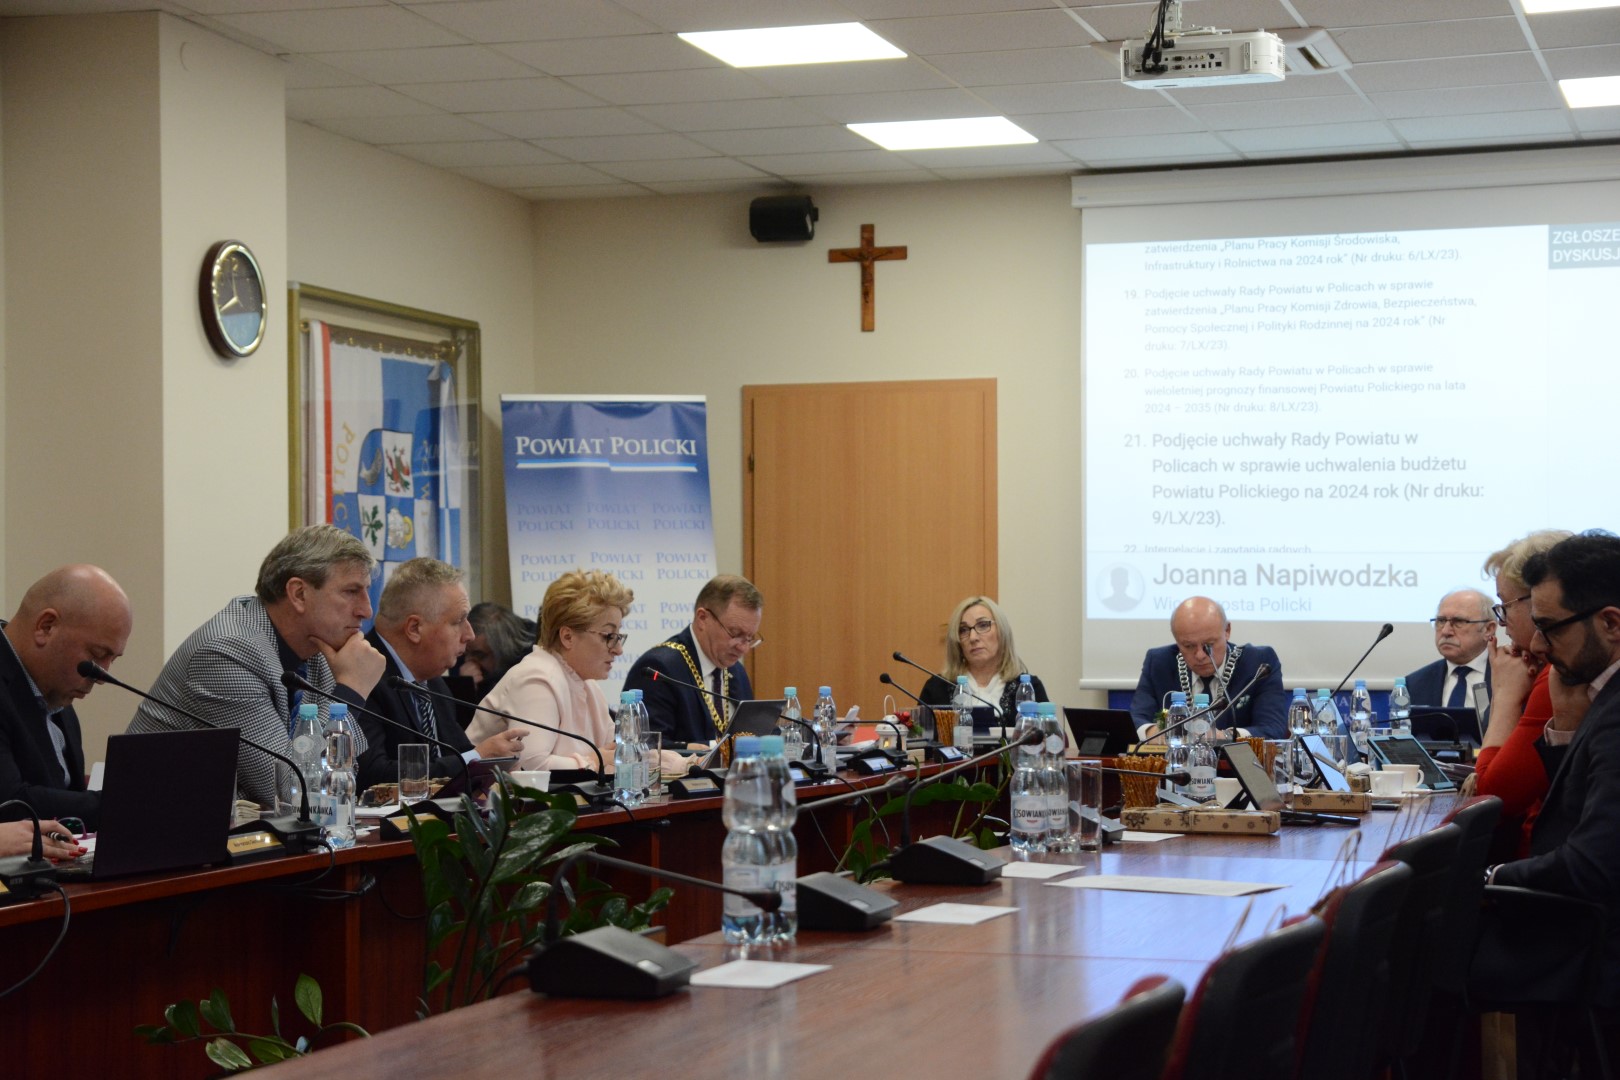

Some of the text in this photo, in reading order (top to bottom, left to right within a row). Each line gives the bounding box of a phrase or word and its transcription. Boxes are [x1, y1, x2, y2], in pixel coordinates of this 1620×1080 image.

[1144, 241, 1217, 253] zatwierdzenia
[1257, 238, 1287, 251] Pracy
[1290, 236, 1331, 250] Komisji
[1144, 258, 1215, 273] Infrastruktury
[1223, 256, 1276, 268] Rolnictwa
[1279, 257, 1293, 266] na
[1295, 253, 1323, 266] 2024
[1350, 251, 1368, 266] (Nr
[1370, 250, 1404, 263] druku:
[1553, 248, 1620, 262] DYSKUSJ
[1144, 287, 1190, 301] Podjęcie
[1192, 286, 1236, 299] uchwały
[1239, 284, 1265, 298] Rady
[1268, 282, 1312, 295] Powiatu
[1315, 285, 1325, 293] w
[1327, 280, 1375, 293] Policach
[1377, 282, 1387, 291] w
[1389, 279, 1434, 292] sprawie
[1144, 304, 1217, 316] zatwierdzenia
[1257, 301, 1287, 315] Pracy
[1290, 300, 1331, 314] Komisji
[1333, 298, 1380, 311] Zdrowia,
[1383, 294, 1478, 311] Bezpieczeństwa,
[1144, 322, 1188, 336] Pomocy
[1189, 320, 1248, 335] Społecznej
[1256, 319, 1296, 333] Polityki
[1299, 318, 1352, 332] Rodzinnej
[1355, 319, 1369, 328] na
[1372, 315, 1400, 328] 2024
[1428, 314, 1445, 328] (Nr
[1144, 340, 1176, 351] druku:
[1144, 367, 1189, 380] Podjęcie
[1192, 366, 1236, 379] uchwały
[1238, 365, 1265, 378] Rady
[1268, 364, 1312, 376] Powiatu
[1314, 367, 1325, 375] w
[1327, 363, 1375, 375] Policach
[1377, 365, 1387, 373] w
[1389, 362, 1433, 375] sprawie
[1144, 379, 1466, 398] wieloletniej prognozy finansowej Powiatu Polickiego na lata
[1144, 402, 1171, 414] 2024
[1184, 401, 1211, 413] 2035
[1213, 402, 1230, 415] (Nr
[1232, 401, 1266, 412] druku:
[515, 436, 697, 456] POWIAT POLICKI
[1124, 430, 1418, 451] 21. Podjęcie uchwały Rady Powiatu w
[1152, 455, 1466, 475] Policach w sprawie uchwalenia budżetu
[1152, 482, 1484, 502] Powiatu Polickiego na 2024 rok (Nr druku:
[517, 520, 574, 532] POLICKI
[653, 519, 705, 530] POLICKI
[1152, 509, 1225, 529] 9/LX/23).
[520, 553, 576, 566] POWIAT
[590, 551, 642, 563] POWIAT
[656, 551, 708, 563] POWIAT
[657, 567, 710, 580] POLICKI
[1152, 562, 1418, 592] Joanna Napiwodzka
[1260, 597, 1312, 612] Policki
